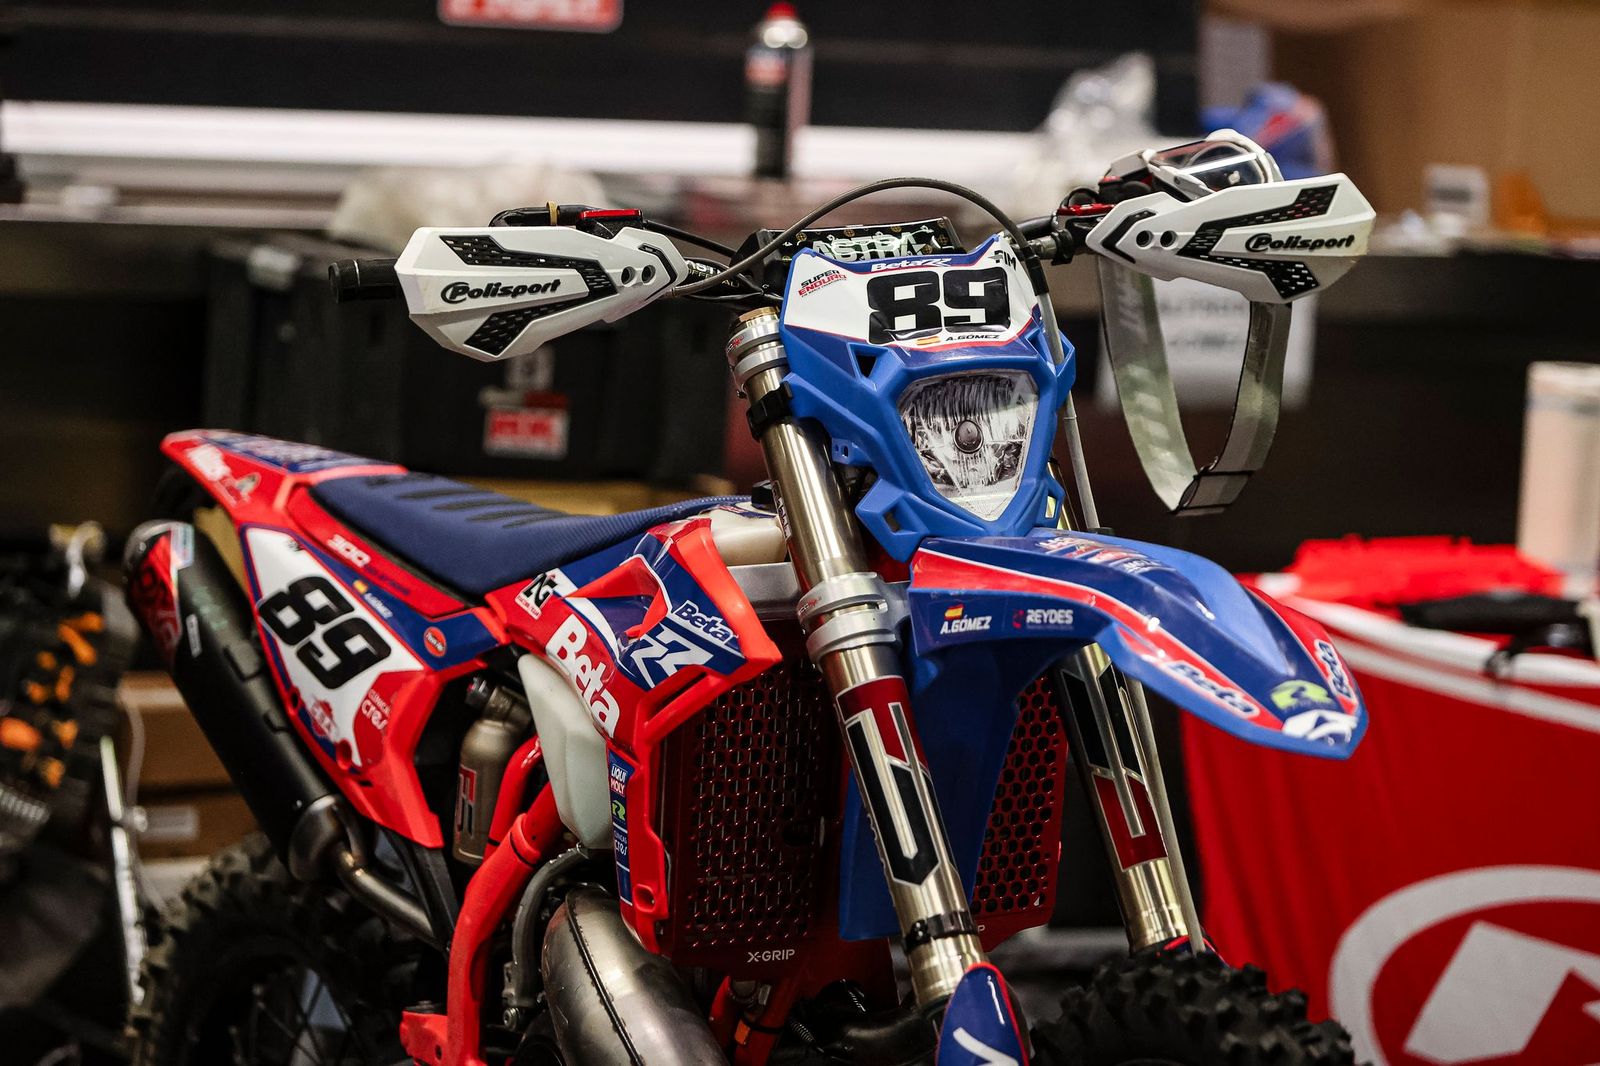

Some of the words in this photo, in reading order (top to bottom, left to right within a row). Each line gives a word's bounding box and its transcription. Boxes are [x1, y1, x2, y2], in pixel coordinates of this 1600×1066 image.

[1245, 233, 1355, 252] Polisport
[798, 274, 847, 296] ENDURO
[800, 269, 840, 288] SUPER
[440, 279, 561, 304] Polisport
[866, 267, 1011, 345] 89
[675, 599, 739, 643] Beta
[939, 614, 992, 635] A.GÓMEZ
[1025, 608, 1074, 625] REYDES
[259, 576, 392, 690] 89
[546, 614, 621, 739] Beta
[1170, 661, 1256, 716] Beta
[610, 778, 626, 795] MOLY
[747, 949, 796, 963] X-GRIP
